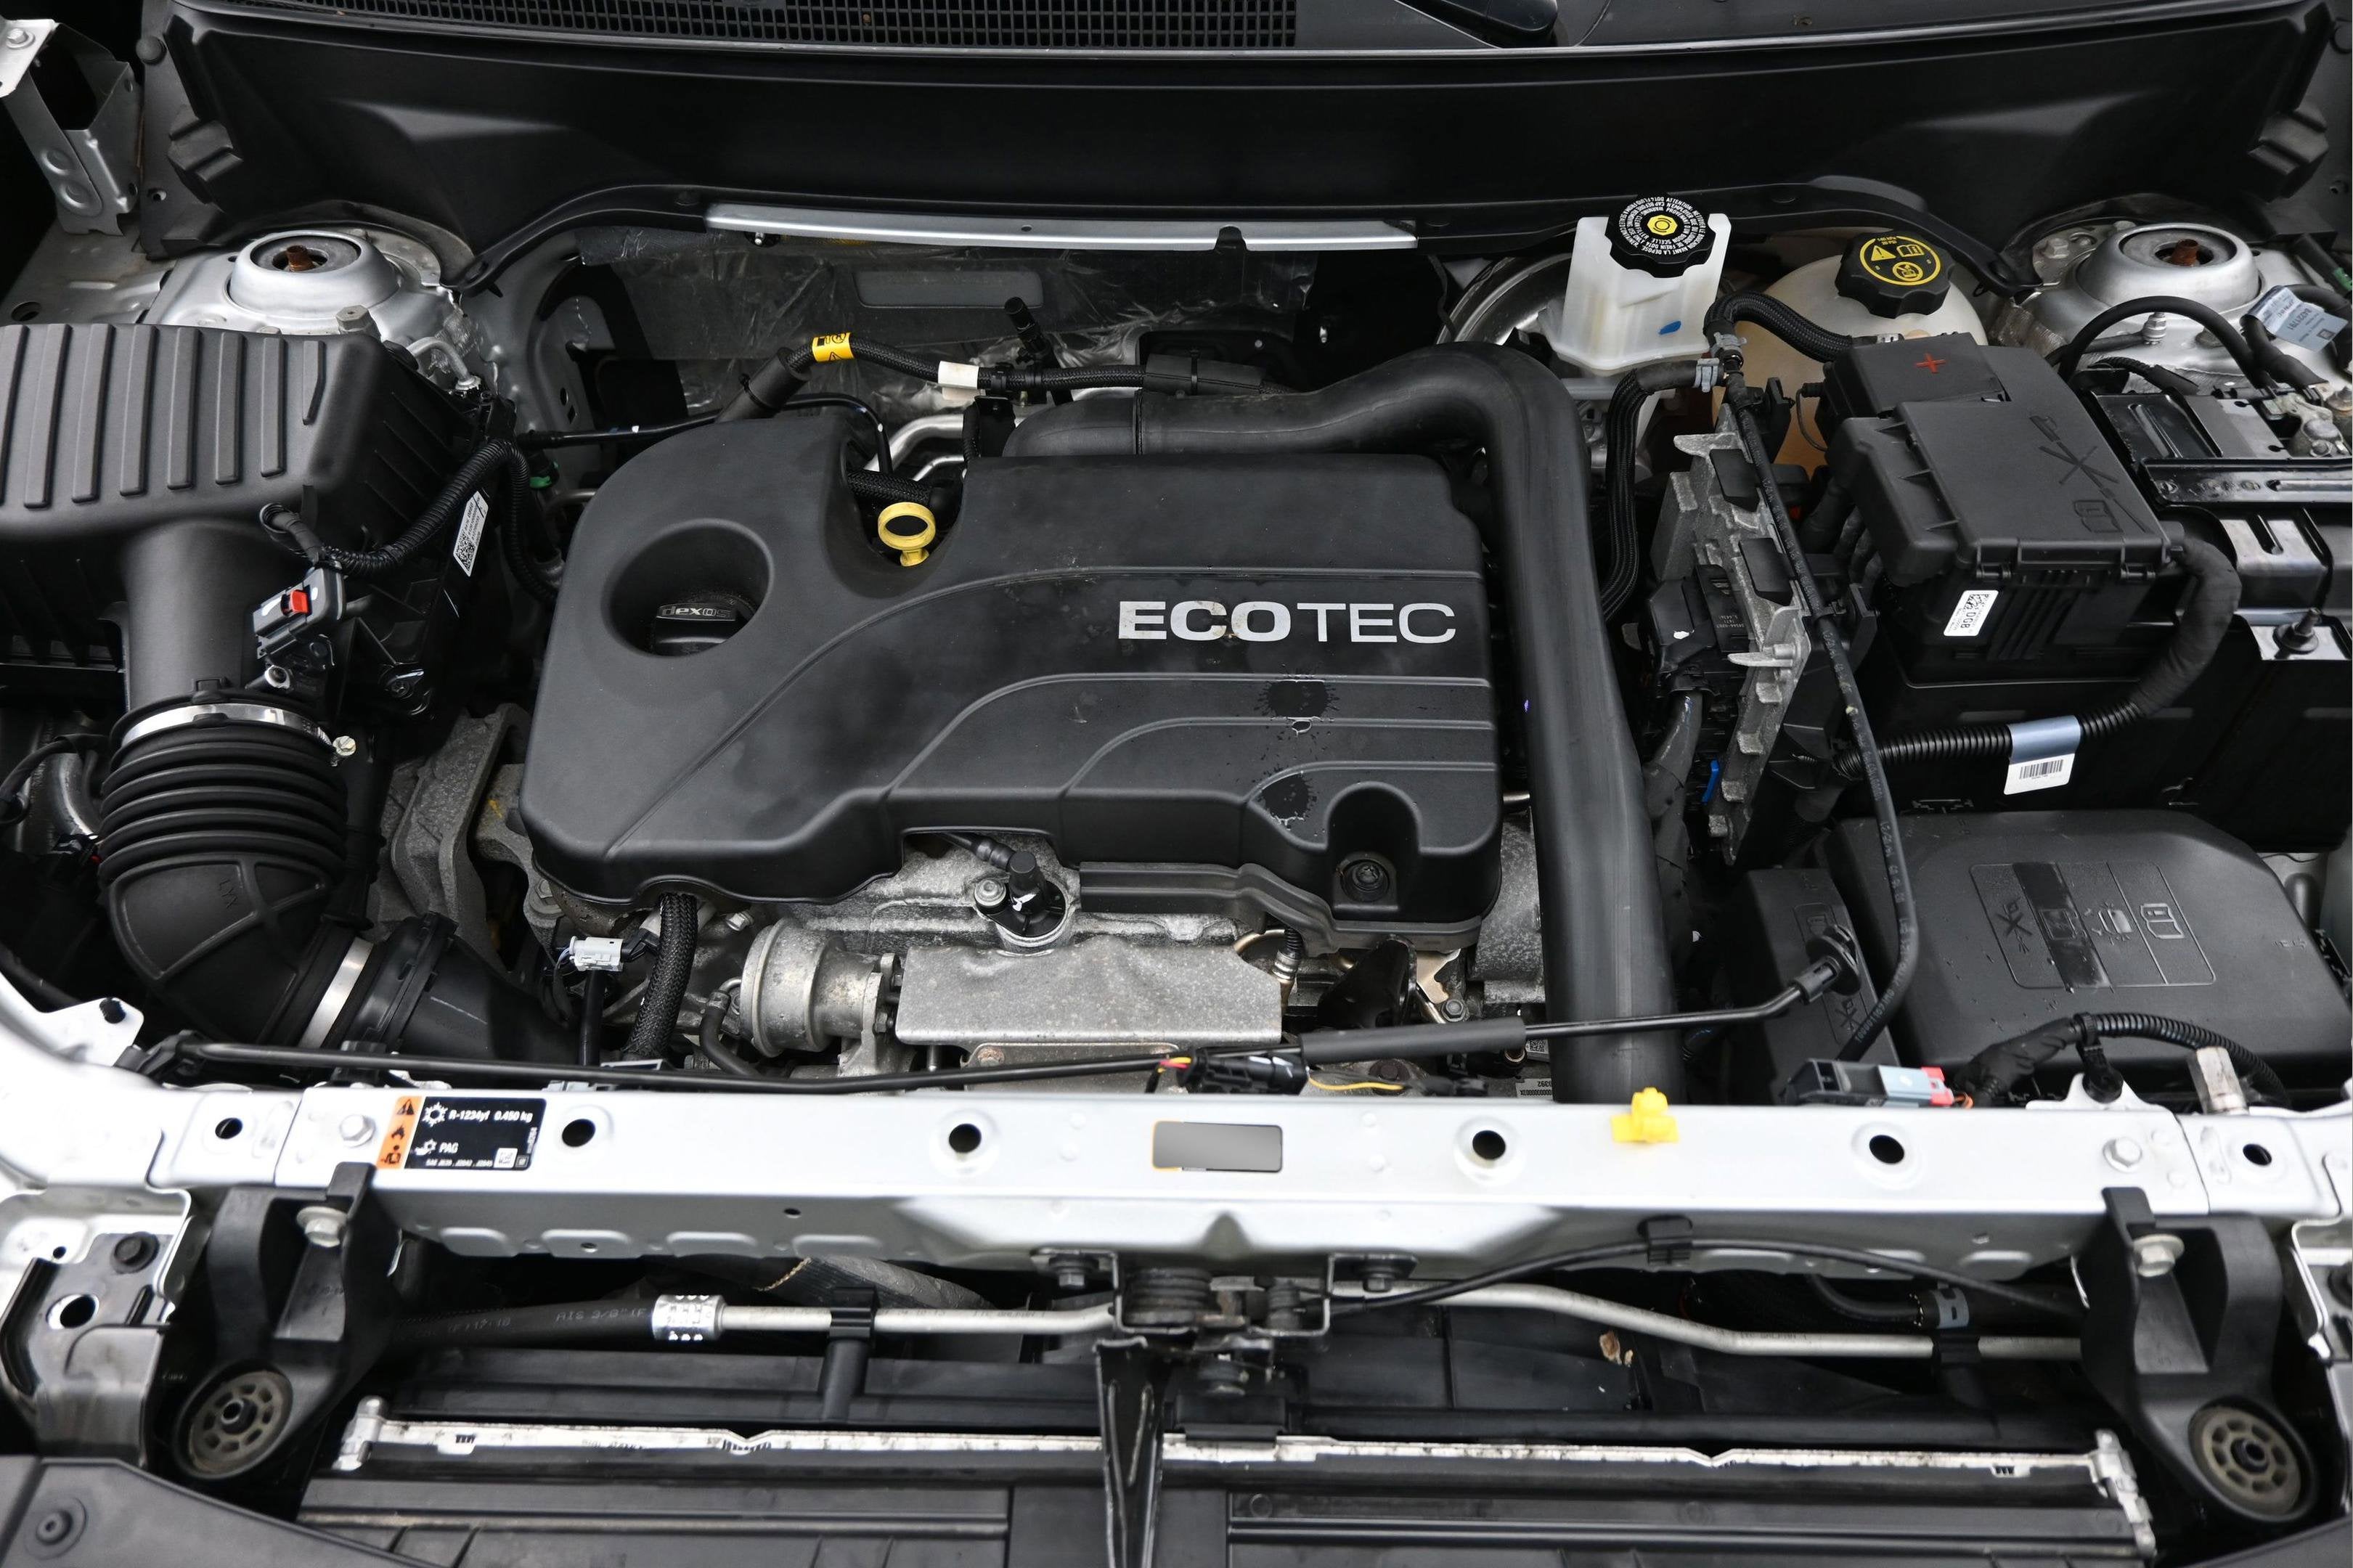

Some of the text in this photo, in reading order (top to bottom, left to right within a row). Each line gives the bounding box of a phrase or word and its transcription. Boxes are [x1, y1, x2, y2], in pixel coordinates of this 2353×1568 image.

[1636, 202, 1655, 211] BEFORE
[1633, 234, 1645, 244] ONLY
[1672, 246, 1688, 255] AVANT
[662, 606, 731, 617] dexos
[1118, 600, 1456, 643] ECOTEC
[448, 1109, 533, 1123] R-1234yf 0.450 kg
[439, 1142, 459, 1153] PAG
